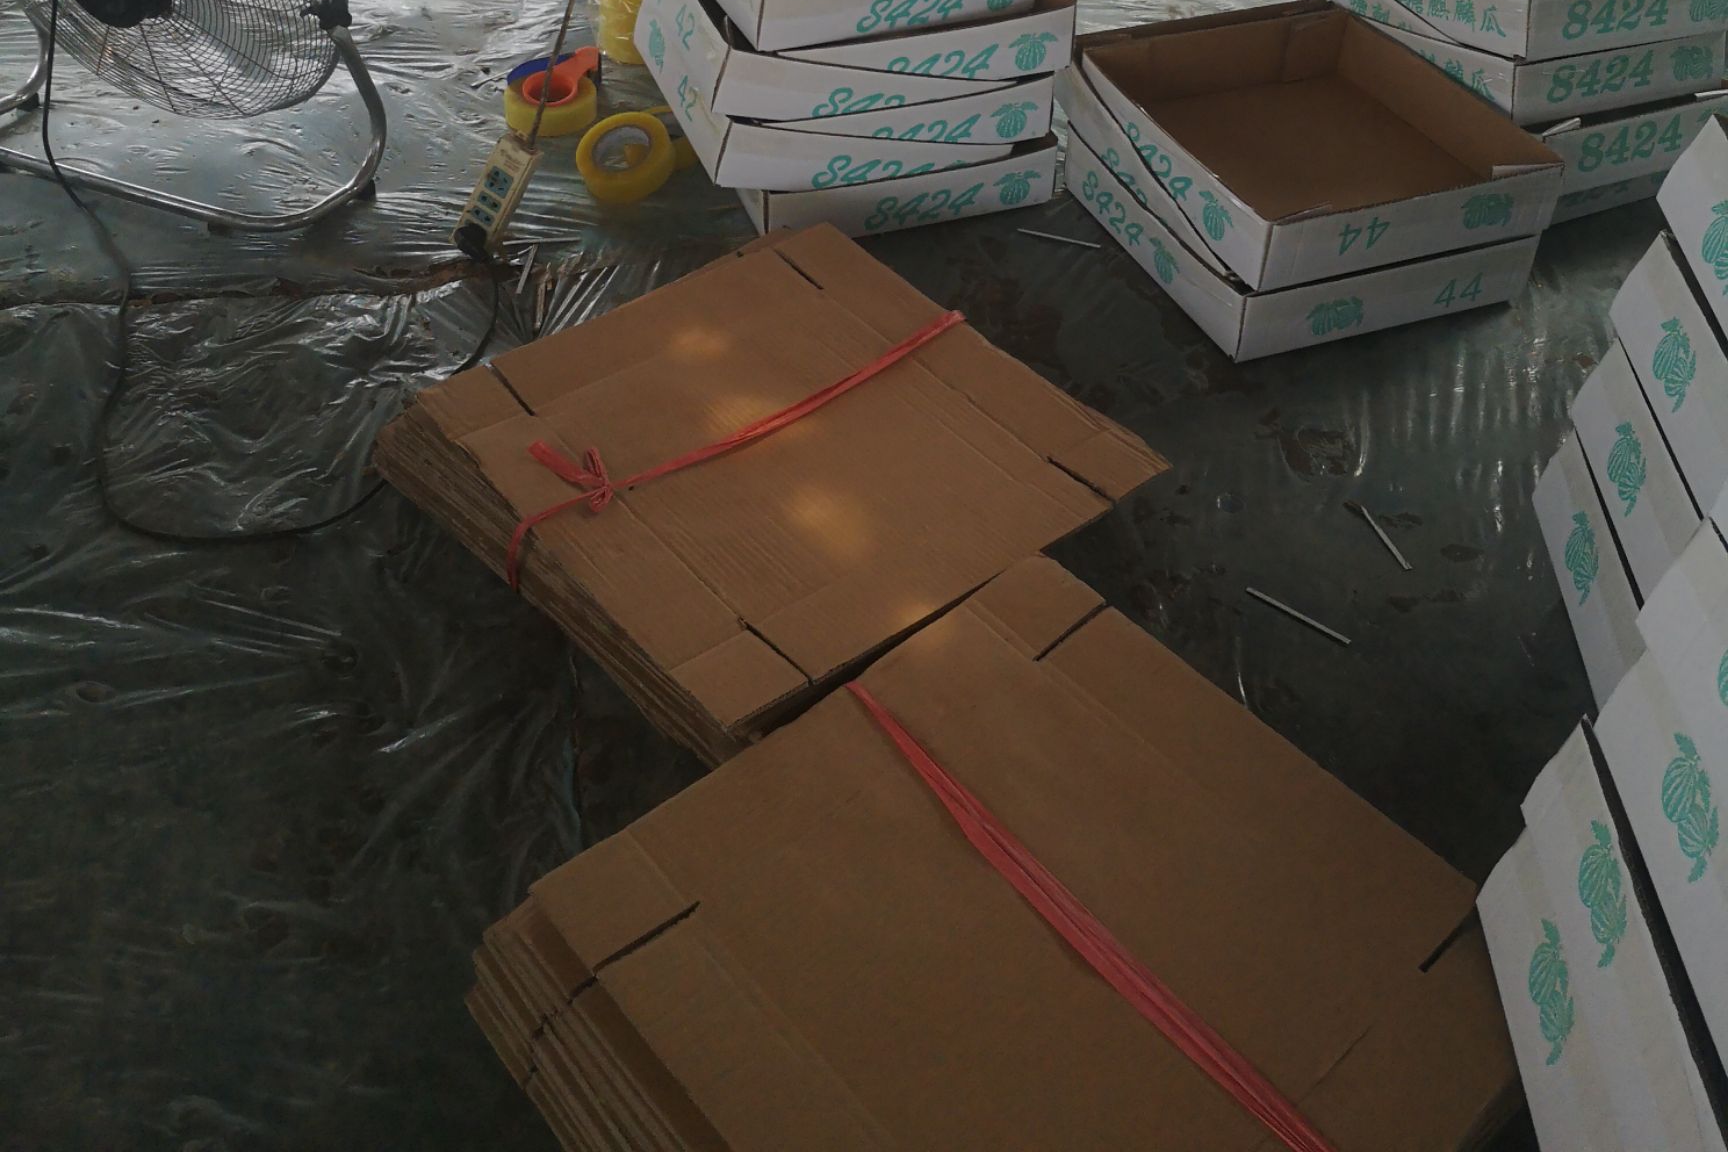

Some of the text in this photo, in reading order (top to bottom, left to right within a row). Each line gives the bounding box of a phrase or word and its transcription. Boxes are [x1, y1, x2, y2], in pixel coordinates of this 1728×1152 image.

[675, 3, 695, 51] 42
[678, 74, 698, 122] 42
[1546, 49, 1654, 104] 8424
[1578, 113, 1682, 172] 8424
[864, 182, 985, 231] 8424
[1083, 170, 1144, 246] 8424
[1338, 216, 1390, 256] 44
[1433, 271, 1484, 308] 44
